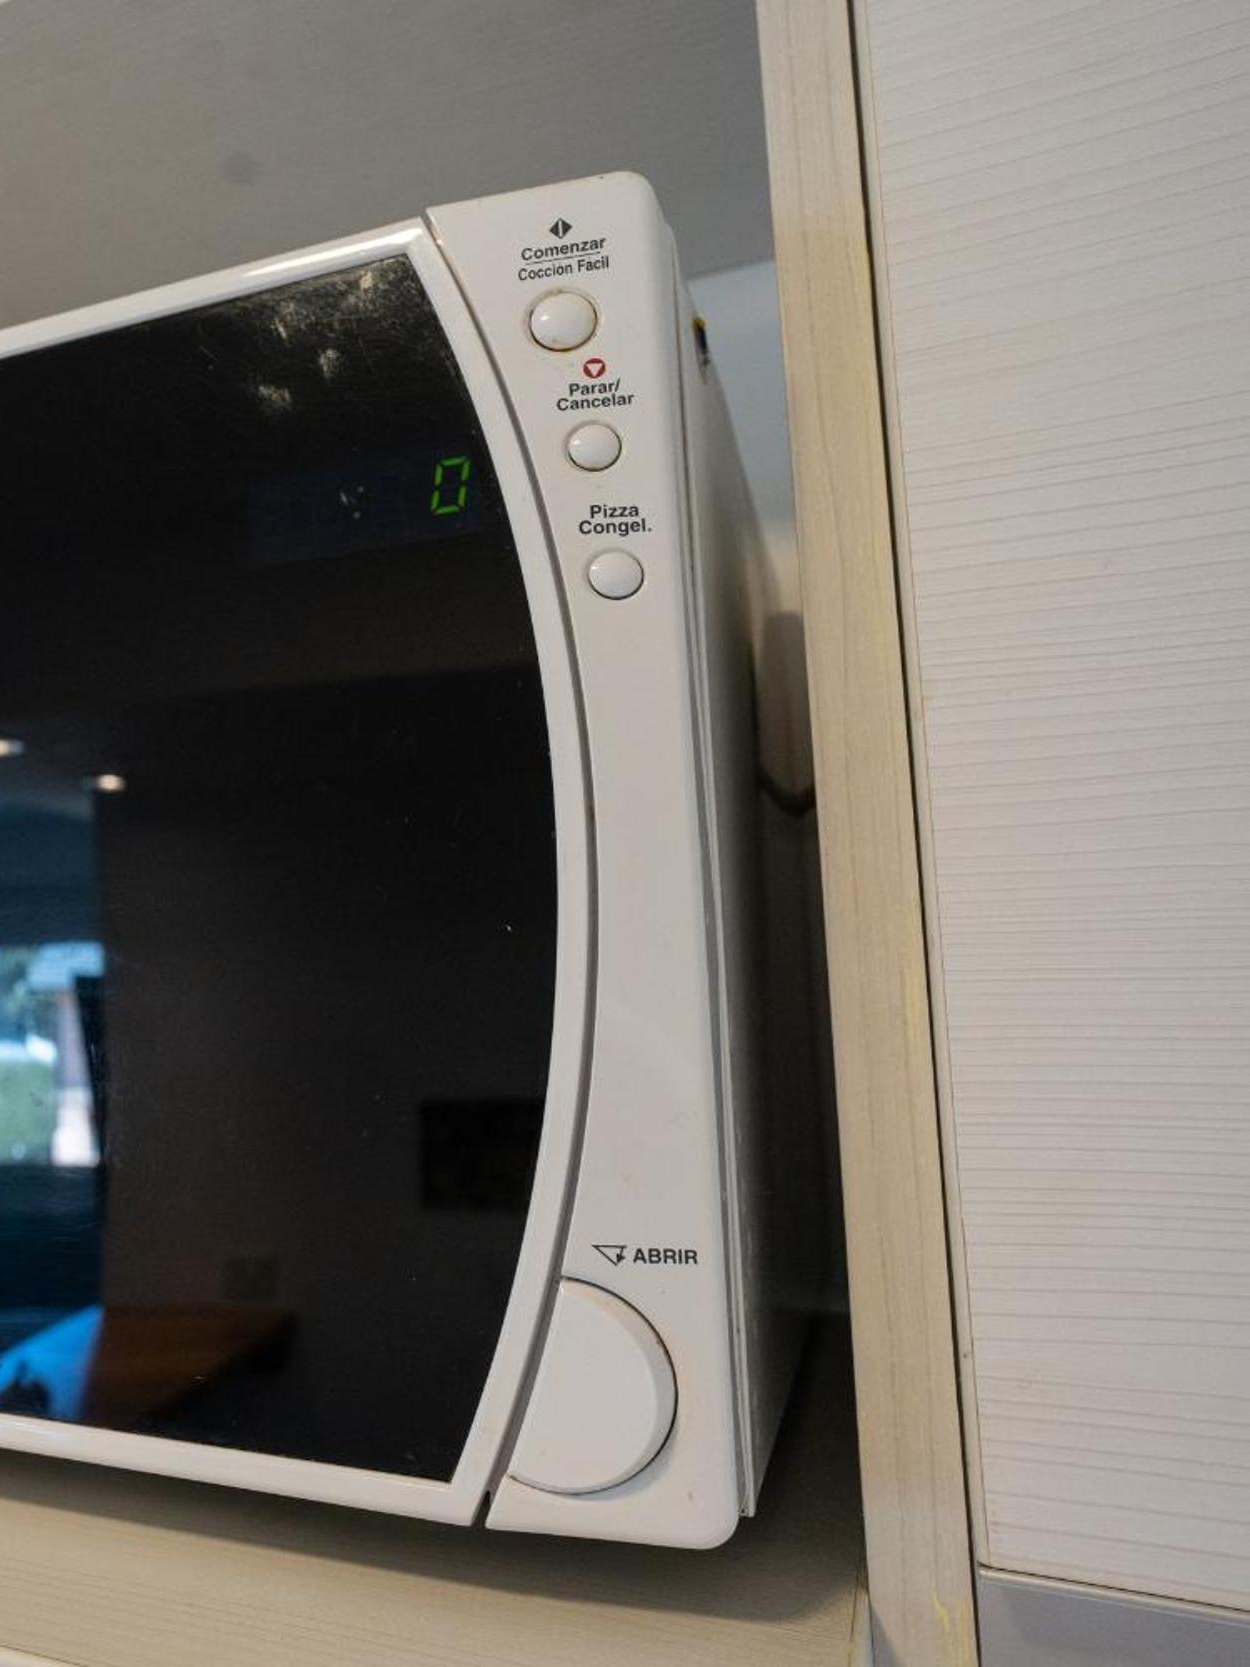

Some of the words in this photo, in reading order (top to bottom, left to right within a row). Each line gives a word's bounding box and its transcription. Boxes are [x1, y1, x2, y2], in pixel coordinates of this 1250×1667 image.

[521, 238, 606, 261] Comenzar
[569, 378, 621, 397] Parar/
[556, 393, 634, 411] Cancelar
[431, 456, 470, 514] 0
[590, 504, 639, 519] Pizza
[579, 518, 652, 537] Congel.
[633, 1248, 698, 1265] ABRIR
